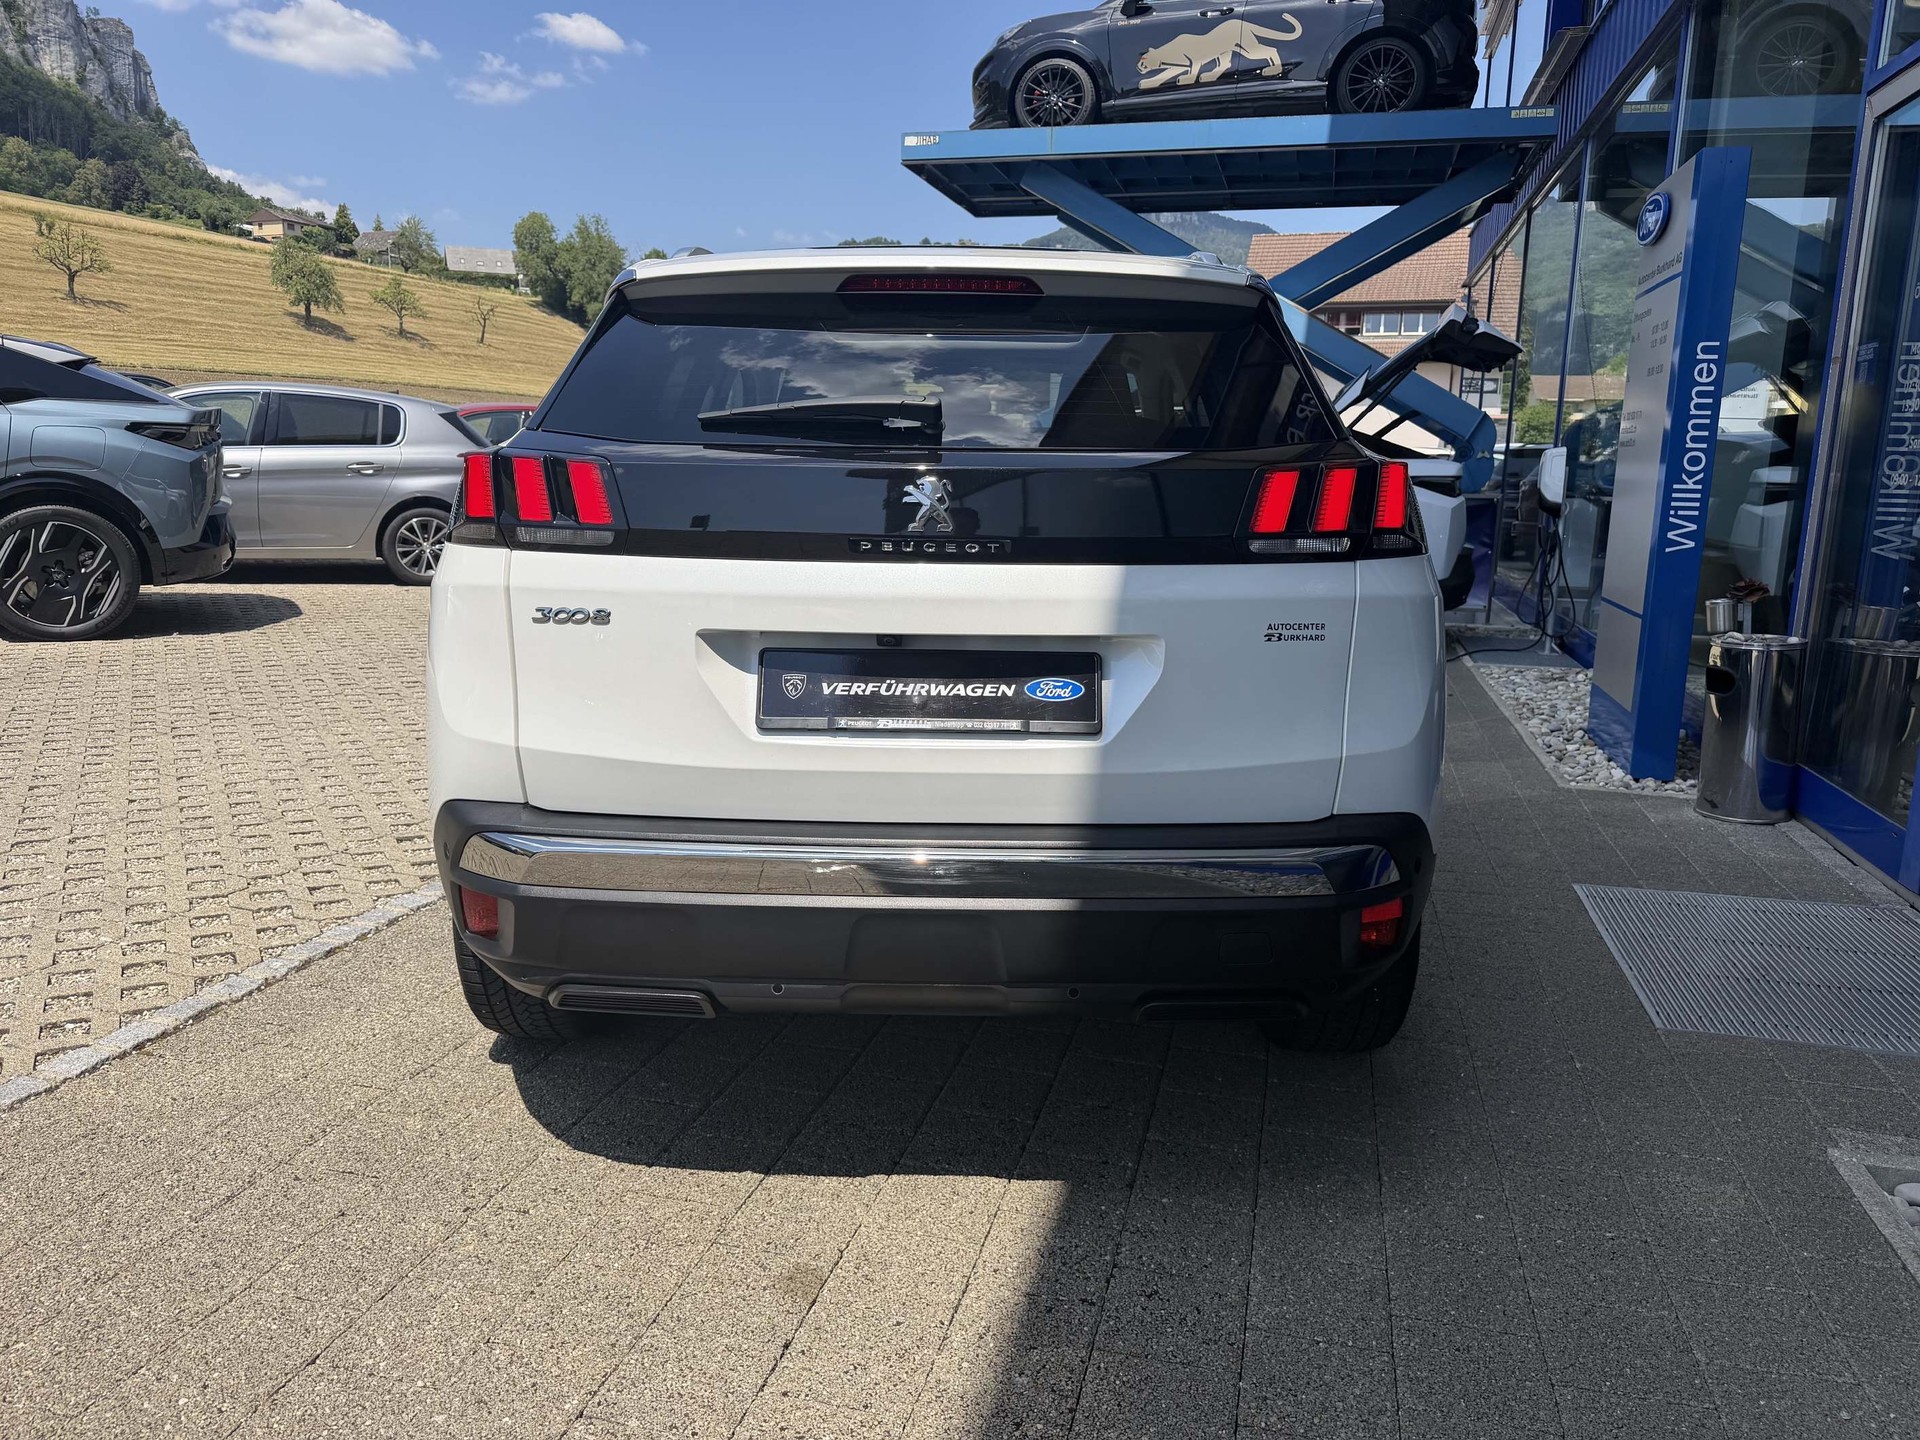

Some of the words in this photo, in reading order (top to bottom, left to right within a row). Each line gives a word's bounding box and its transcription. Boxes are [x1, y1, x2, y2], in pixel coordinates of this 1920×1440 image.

[1664, 341, 1721, 553] Willkommen
[860, 541, 1000, 553] PEUGEOT
[531, 606, 612, 626] 3008
[1266, 622, 1326, 631] AUTOCENTER
[1263, 632, 1326, 642] BURKHARD
[821, 680, 1017, 697] VERFÜHRWAGEN
[1036, 680, 1072, 697] Ford
